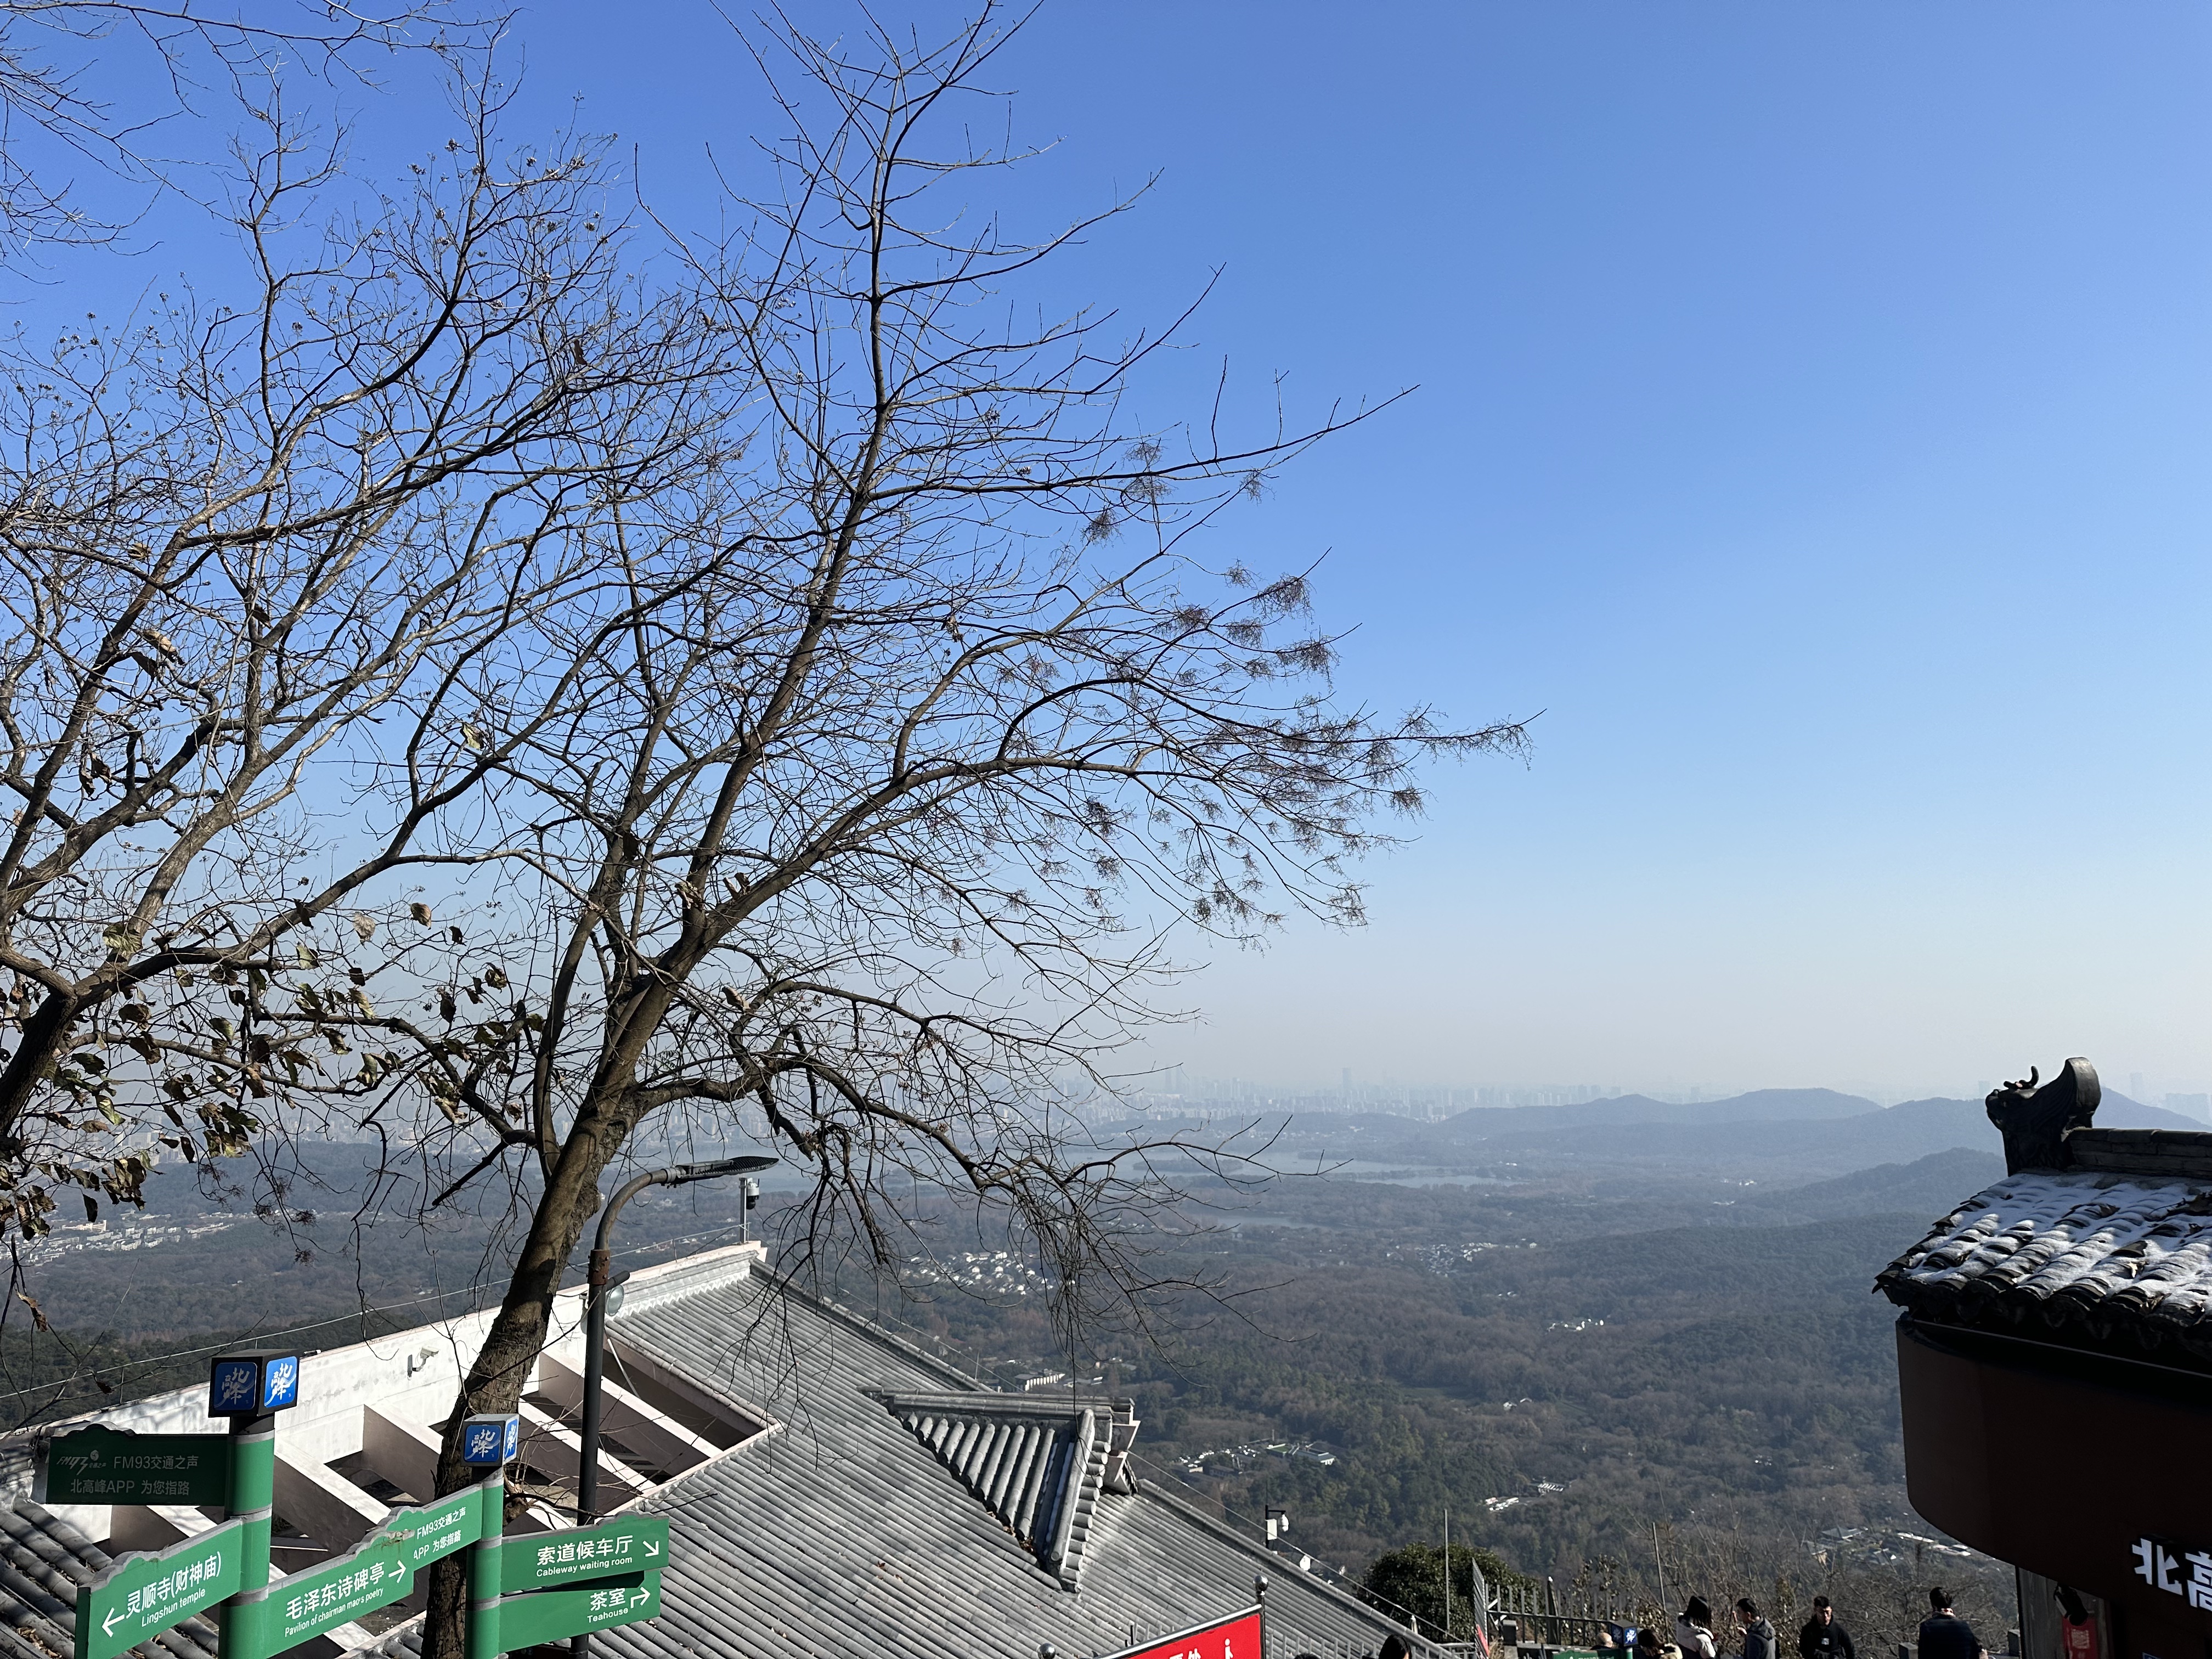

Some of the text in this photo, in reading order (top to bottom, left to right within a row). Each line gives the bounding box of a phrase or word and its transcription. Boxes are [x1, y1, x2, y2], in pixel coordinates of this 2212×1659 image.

[114, 1455, 199, 1470] FM93交通之声
[70, 1479, 190, 1496] 北高峰APP 为您指路
[416, 1506, 466, 1539] FM93交通之声
[413, 1529, 461, 1560] APP 为您指路
[537, 1535, 633, 1566] 索道候车厅
[536, 1557, 633, 1577] Cableway waiting room
[126, 1551, 222, 1619] 灵顺寺(财神庙)
[285, 1561, 385, 1620] 毛泽东诗碑亭
[589, 1588, 626, 1612] 茶室
[141, 1588, 206, 1628] Lingshun temple
[285, 1587, 383, 1638] Pavilion of chairman mao's poetry
[587, 1607, 629, 1623] Teahouse
